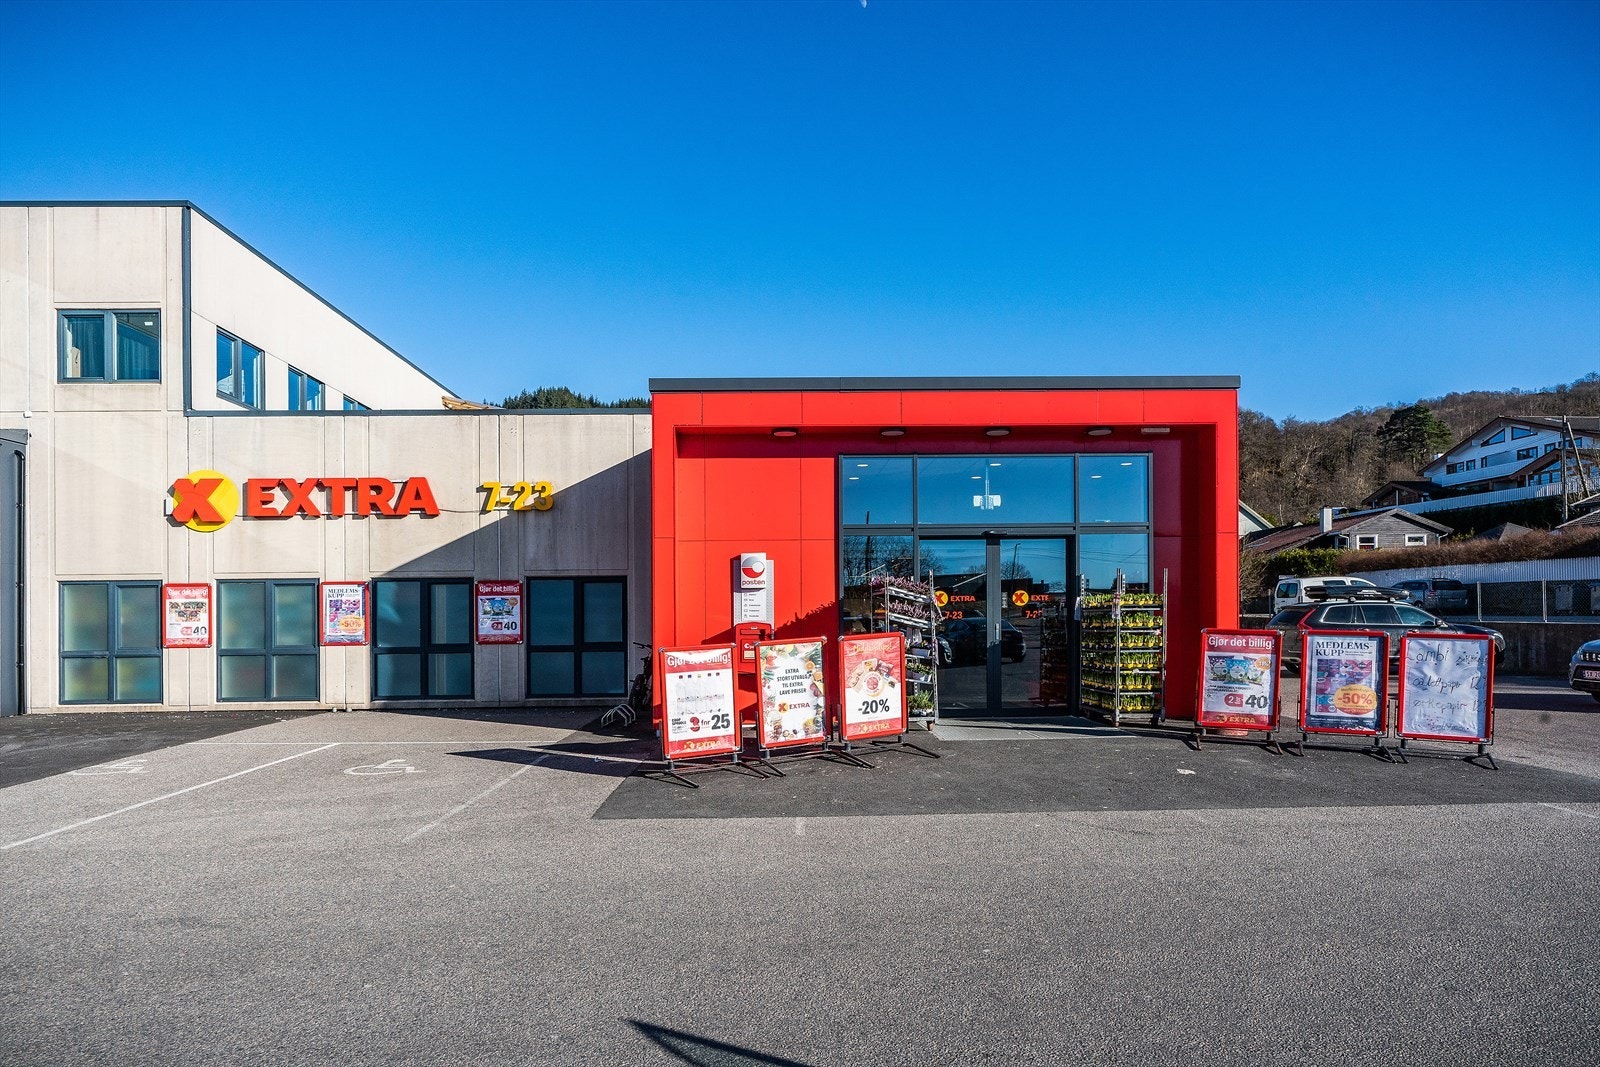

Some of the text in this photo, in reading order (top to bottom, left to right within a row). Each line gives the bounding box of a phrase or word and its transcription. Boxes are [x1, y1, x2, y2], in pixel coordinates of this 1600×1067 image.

[247, 476, 441, 517] EXTRA
[482, 481, 554, 512] 7-23
[945, 611, 963, 619] 7-23
[341, 620, 362, 628] -50%
[503, 621, 518, 631] 40
[193, 626, 207, 636] 40
[1208, 636, 1275, 650] Gjør det billig!
[1315, 641, 1373, 650] MEDLEMS-
[1228, 696, 1233, 704] 2
[1245, 694, 1269, 709] 40
[1337, 692, 1373, 705] -50%
[789, 702, 811, 710] EXTRA
[858, 698, 890, 715] -20%
[711, 713, 731, 730] 25
[1229, 715, 1256, 723] EXTRA
[868, 722, 890, 731] EXTRA
[695, 740, 721, 750] EXTRA
